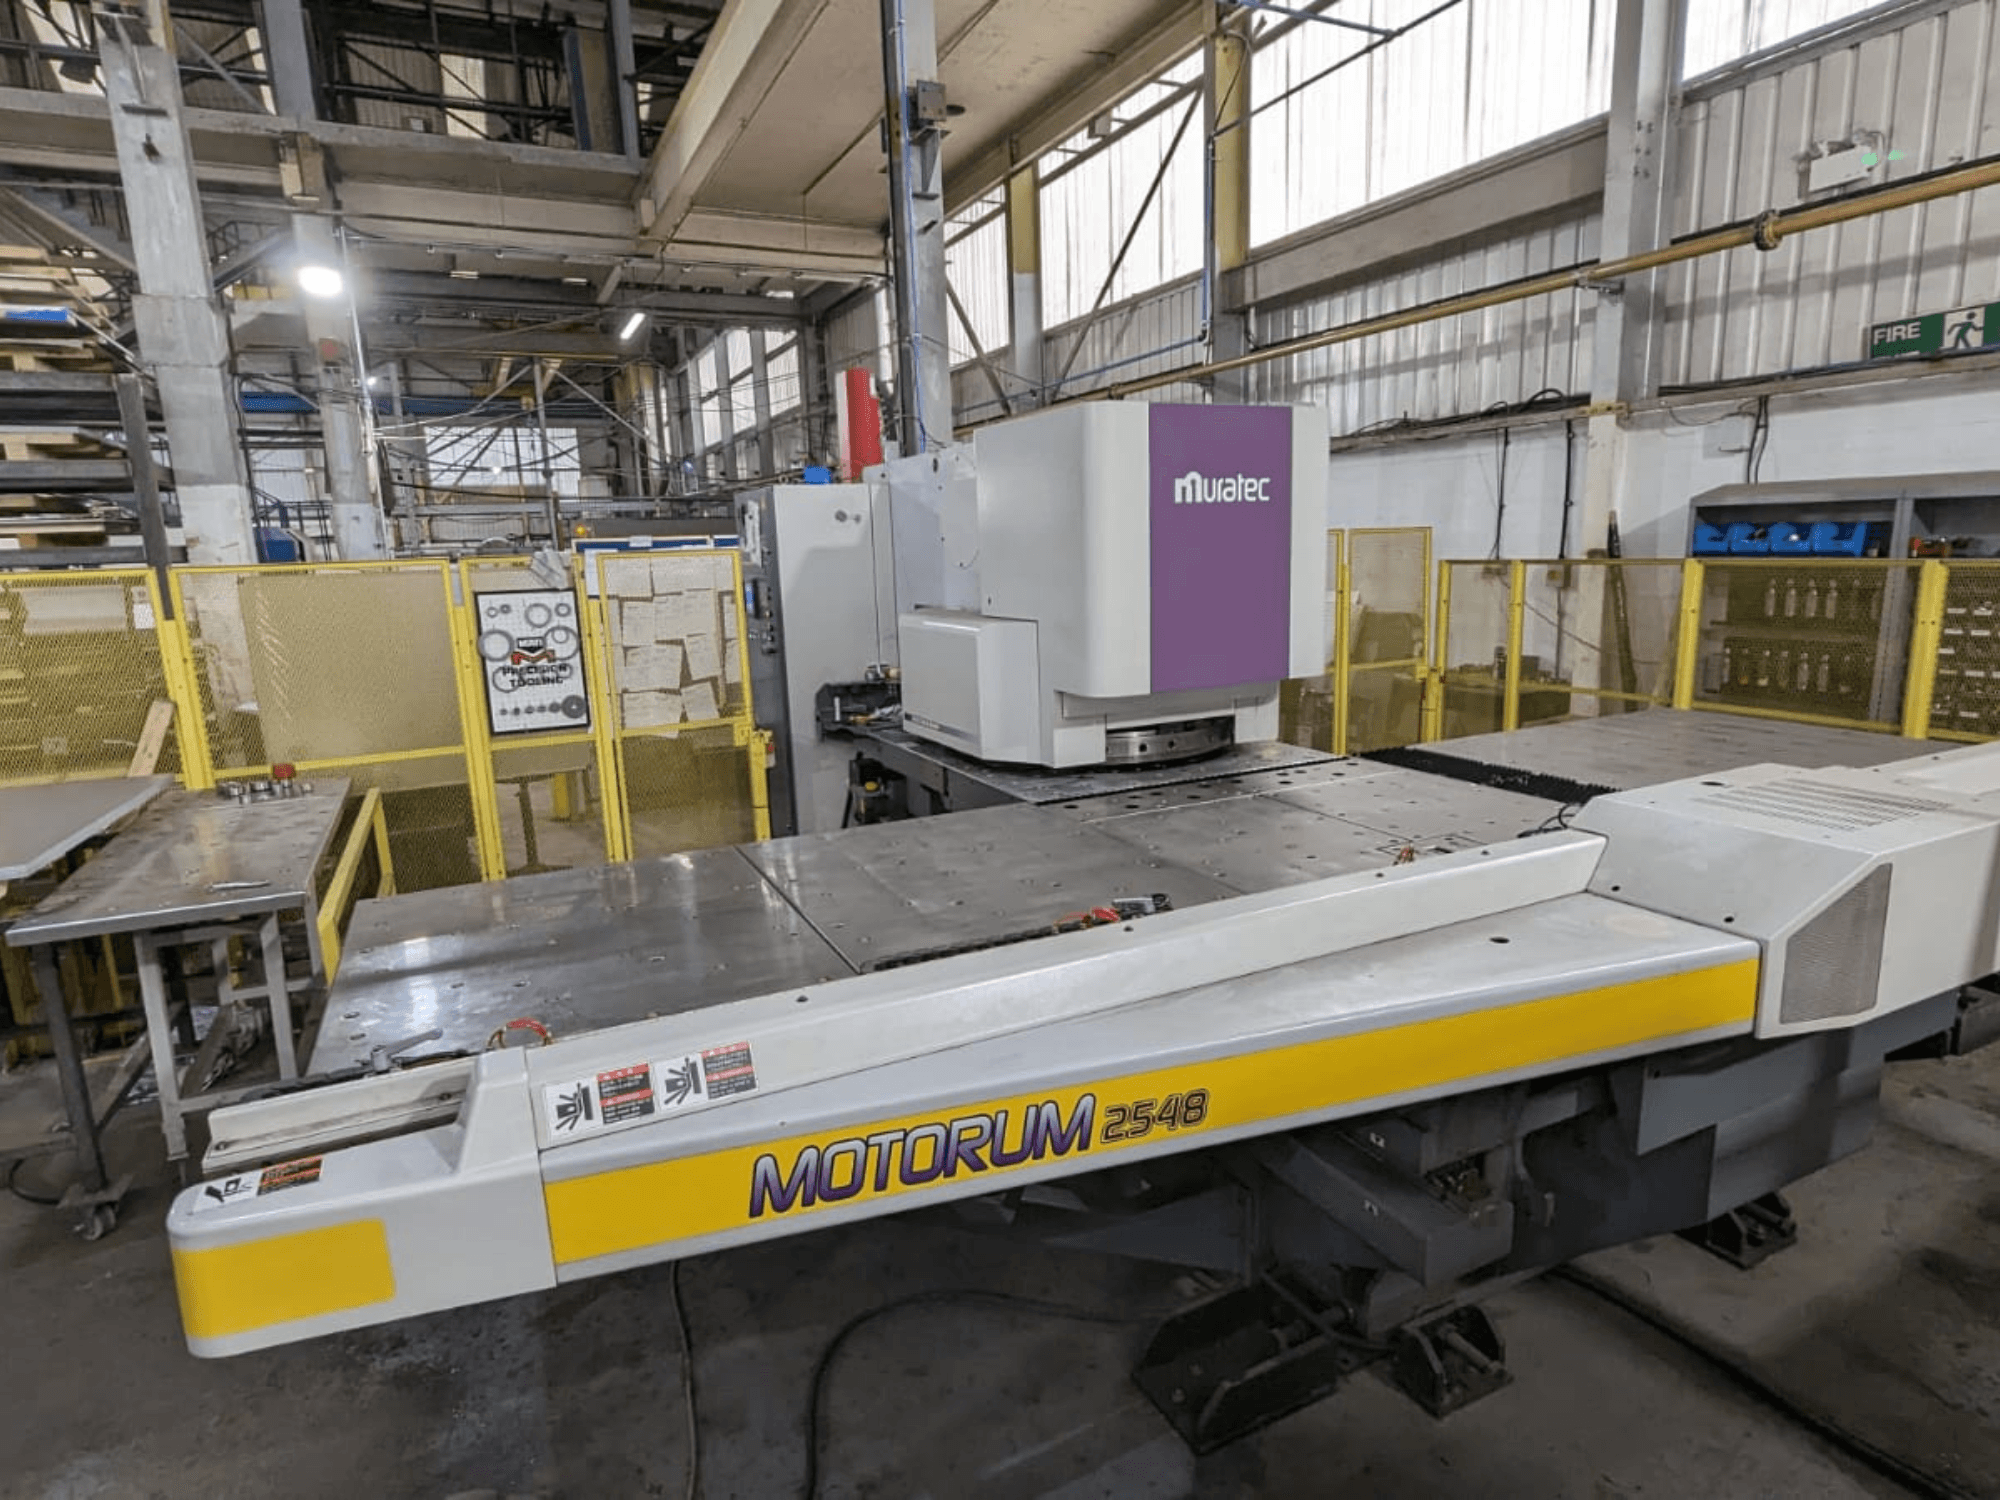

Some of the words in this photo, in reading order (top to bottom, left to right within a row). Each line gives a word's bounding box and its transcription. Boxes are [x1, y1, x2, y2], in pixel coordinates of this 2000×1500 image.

[1873, 321, 1921, 345] FIRE
[749, 1093, 1096, 1218] MOTORUM
[1101, 1088, 1210, 1144] 2548
